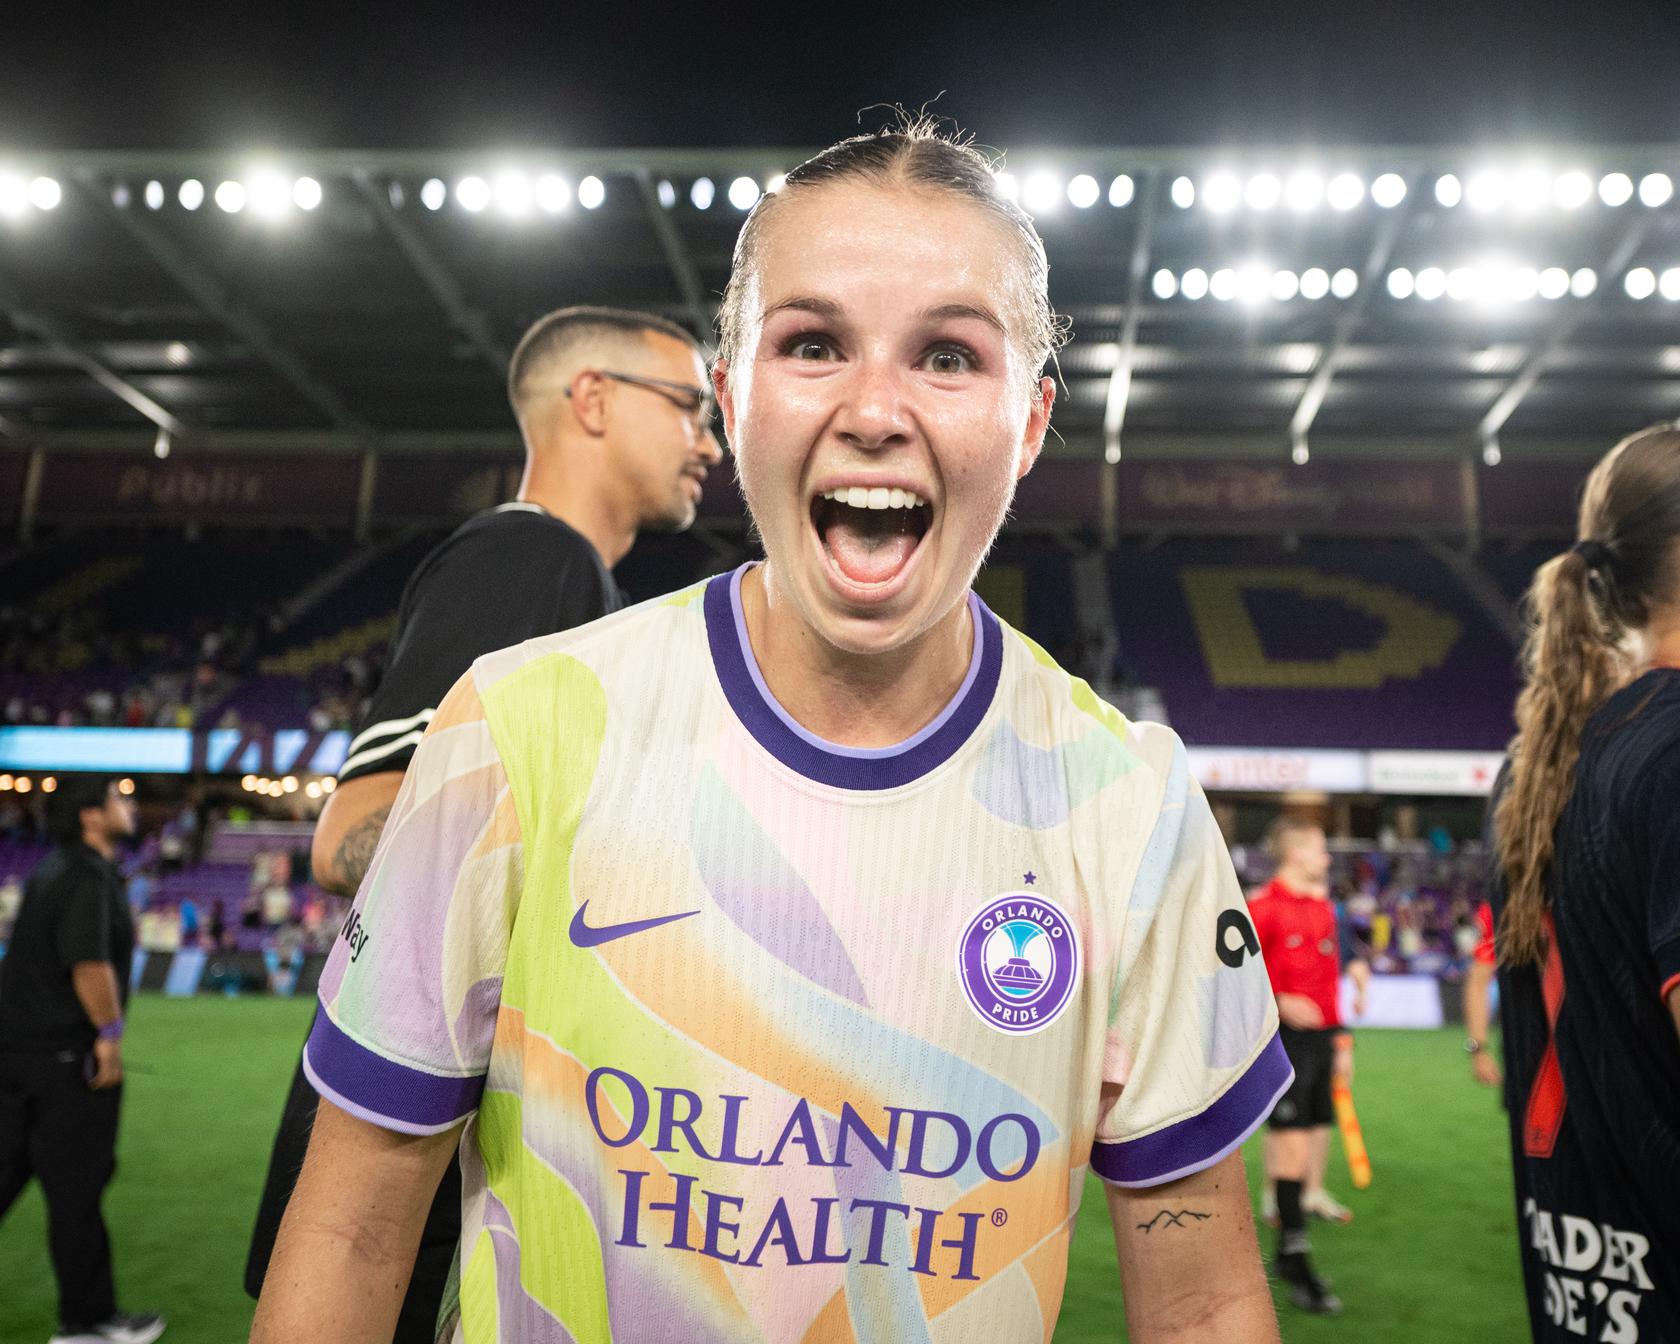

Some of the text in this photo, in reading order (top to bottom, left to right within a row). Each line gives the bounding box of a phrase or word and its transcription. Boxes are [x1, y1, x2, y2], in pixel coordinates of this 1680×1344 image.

[982, 905, 1063, 938] ORLANDO
[992, 1003, 1039, 1022] PRIDE
[585, 1066, 1041, 1182] ORLANDO
